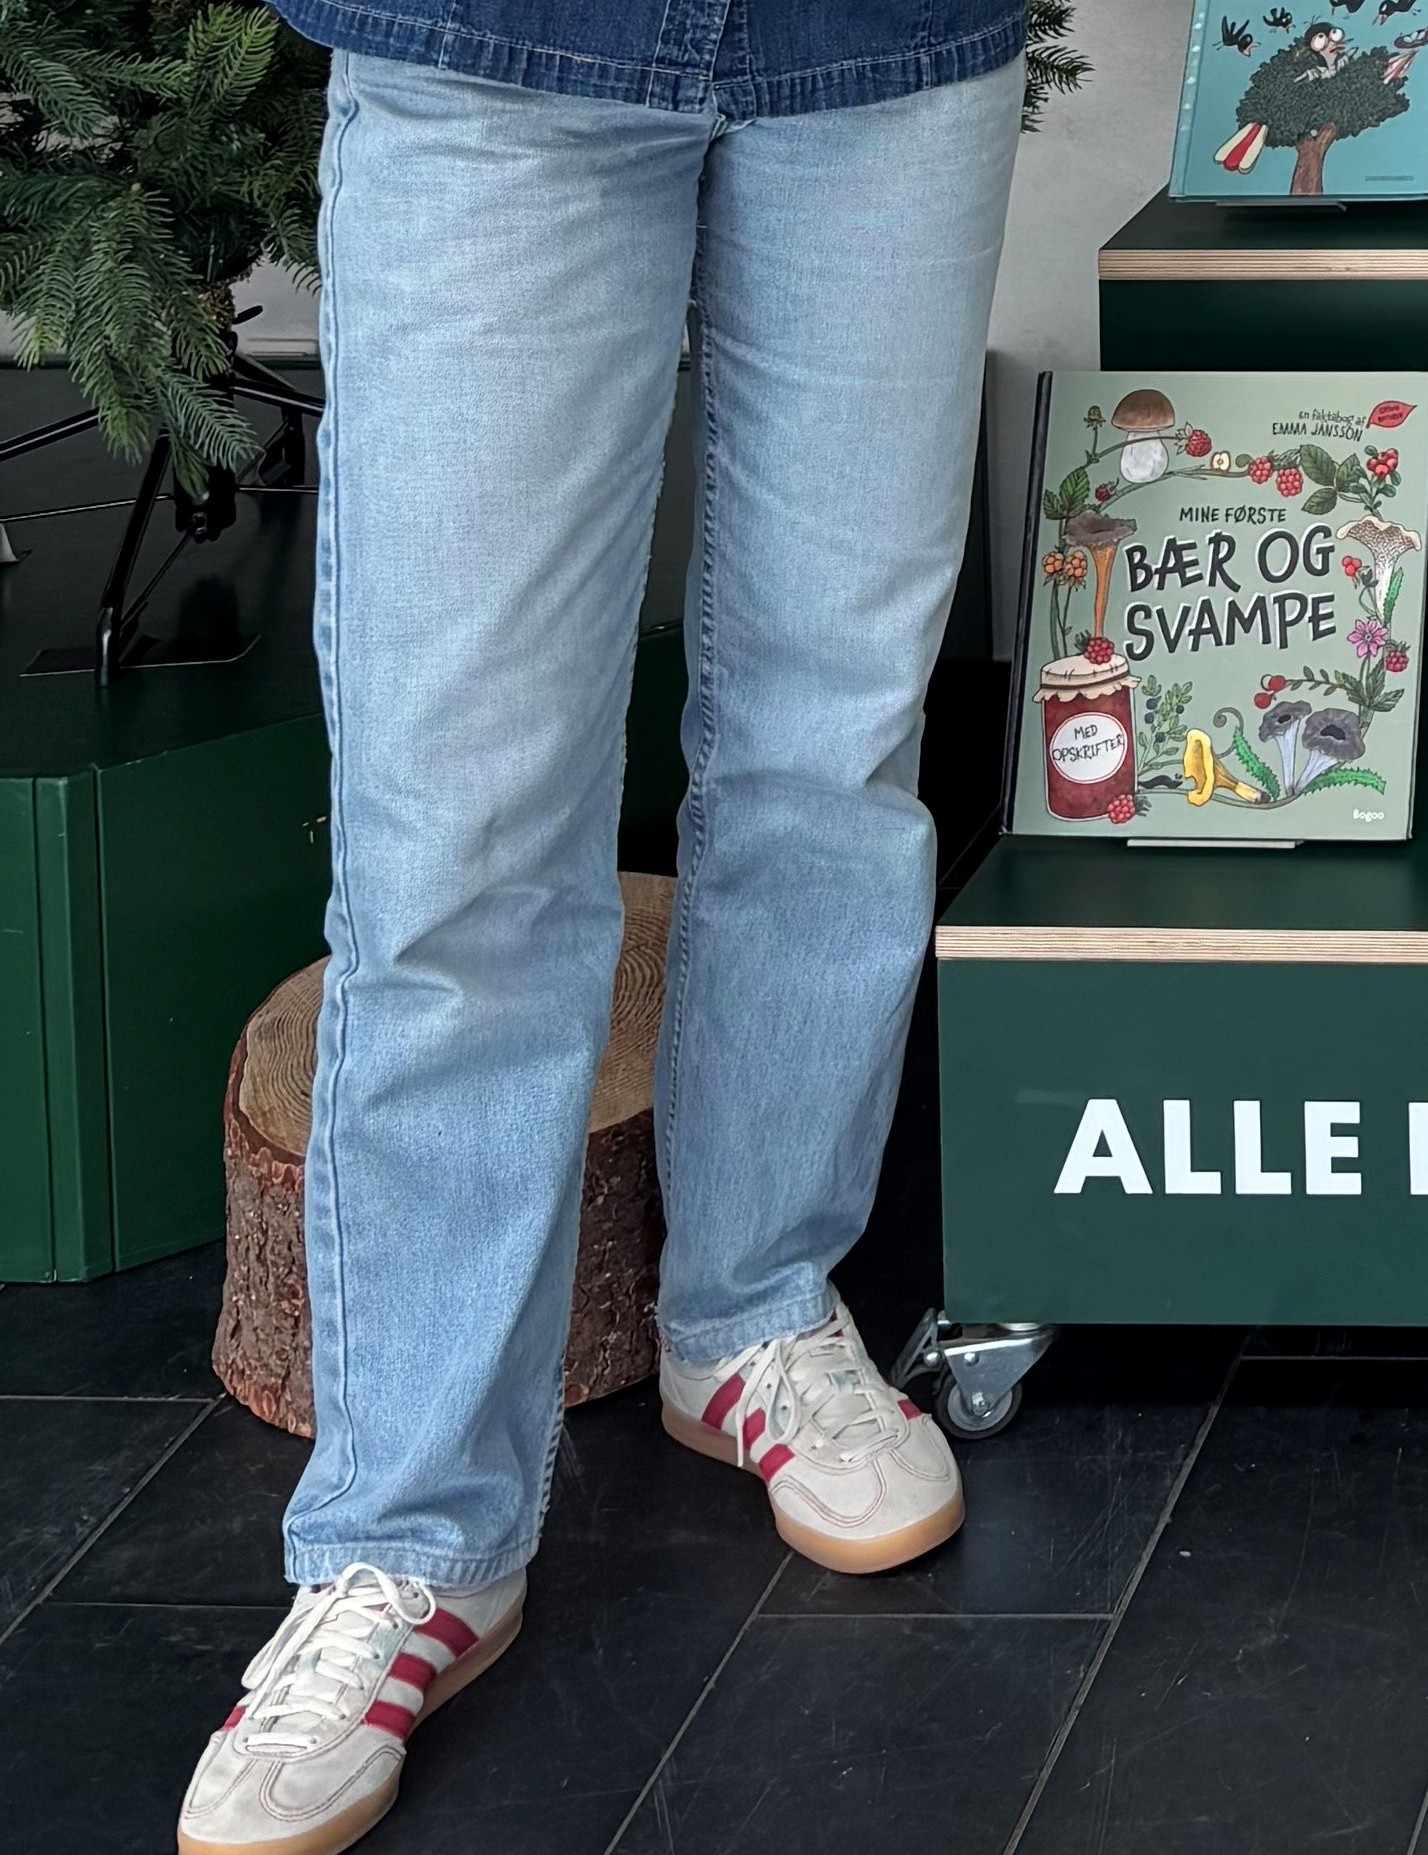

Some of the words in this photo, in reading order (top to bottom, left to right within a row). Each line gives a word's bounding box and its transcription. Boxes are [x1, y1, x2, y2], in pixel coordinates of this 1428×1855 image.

[1311, 409, 1355, 427] faktabog
[1272, 423, 1308, 436] EMMA
[1311, 424, 1363, 442] JANSSON
[1180, 506, 1220, 523] MINE
[1225, 505, 1287, 524] FØRSTE
[1126, 530, 1242, 592] BÆR
[1258, 524, 1336, 585] OG
[1125, 592, 1337, 662] SVAMPE
[1074, 724, 1098, 740] MED
[1052, 732, 1125, 762] OPSKRIFTER
[1054, 1099, 1361, 1194] ALLE
